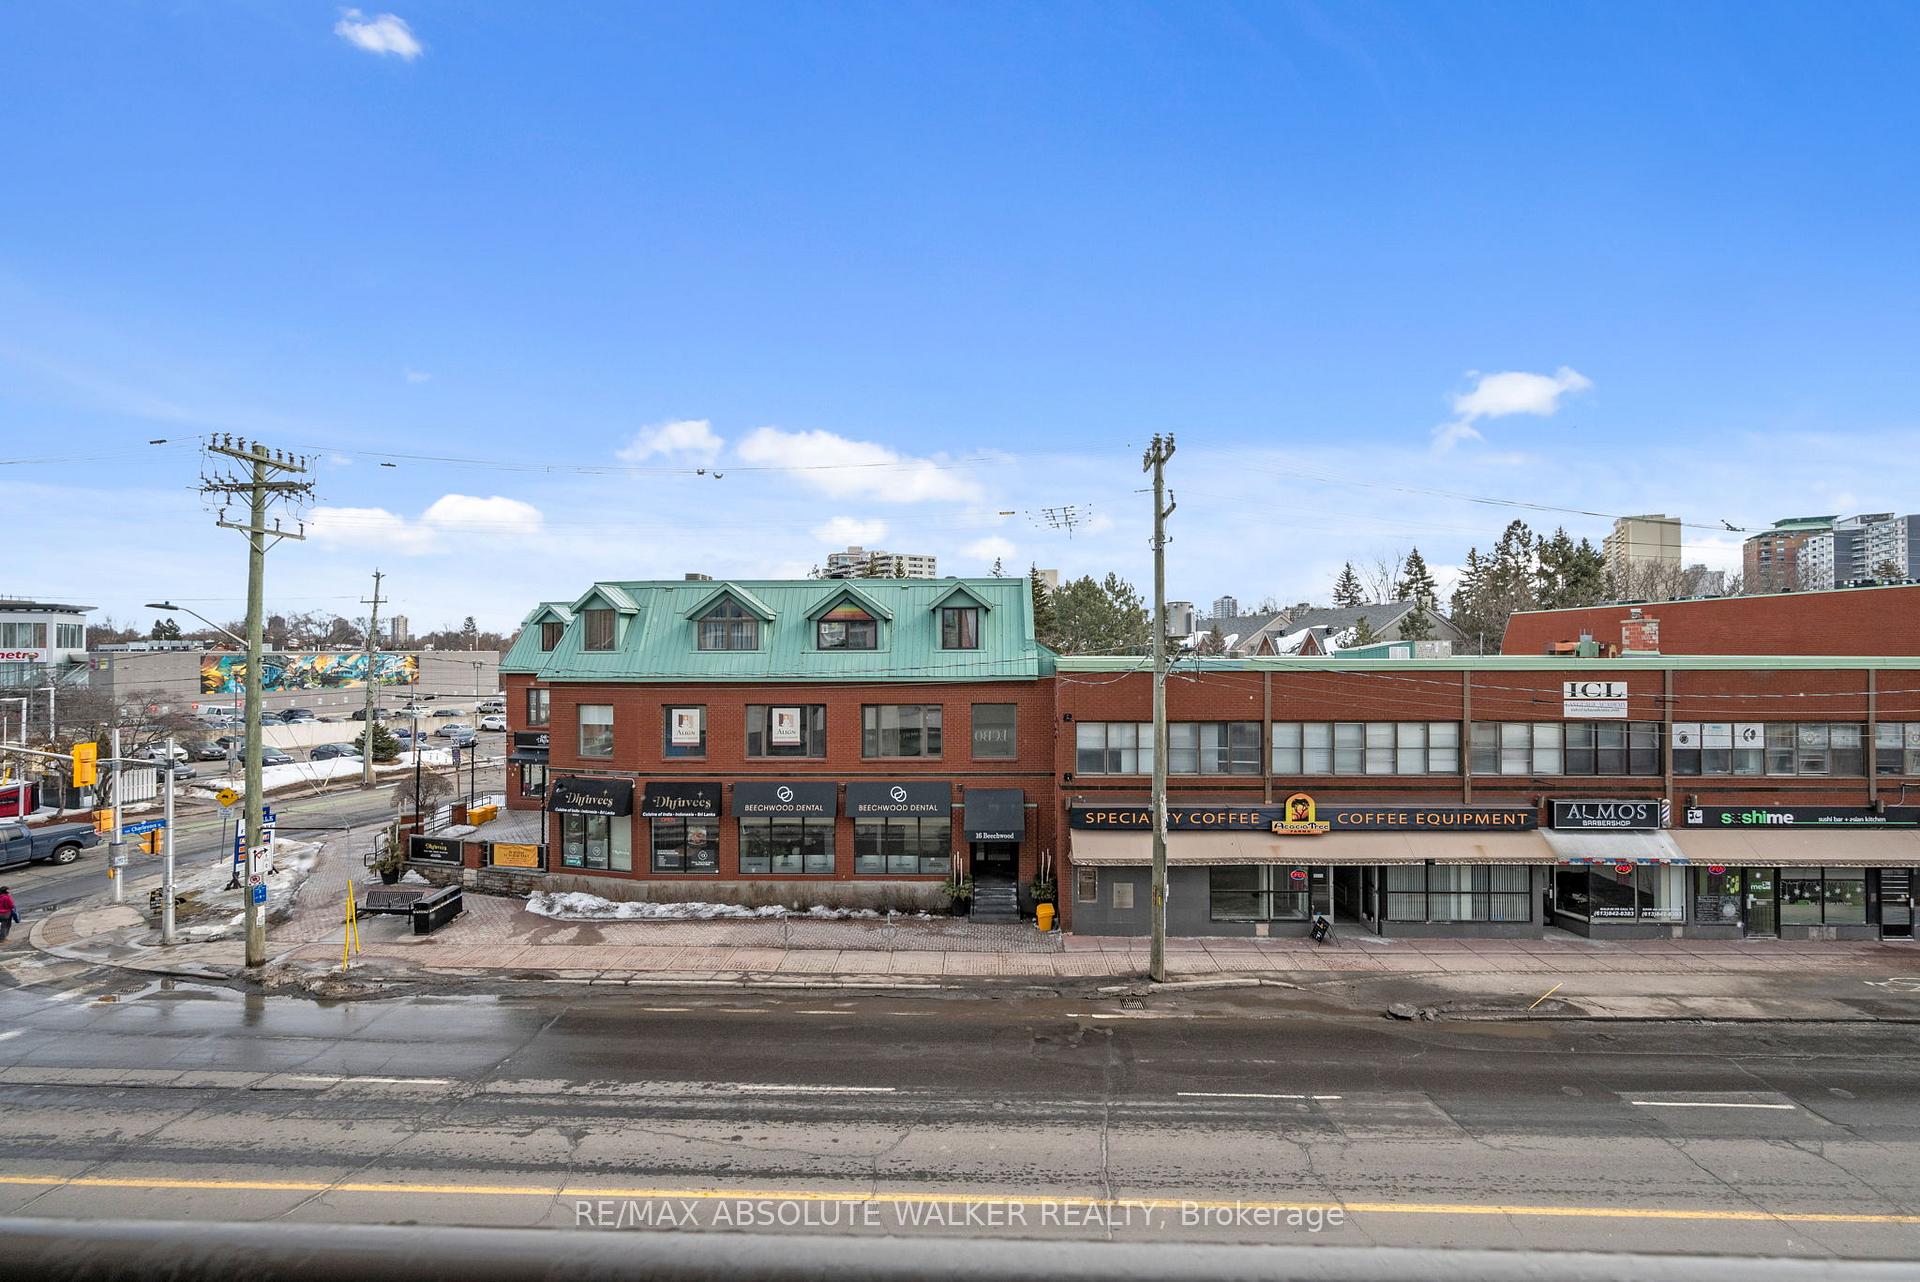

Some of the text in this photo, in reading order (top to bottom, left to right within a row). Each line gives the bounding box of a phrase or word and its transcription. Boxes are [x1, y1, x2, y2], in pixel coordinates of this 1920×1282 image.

[1568, 682, 1622, 698] ICL
[1085, 812, 1260, 824] SPECIAY COFFEE
[1566, 804, 1647, 820] ALMOS
[1720, 810, 1794, 824] sshime
[1337, 813, 1529, 826] COFFEE EQUIPMENT
